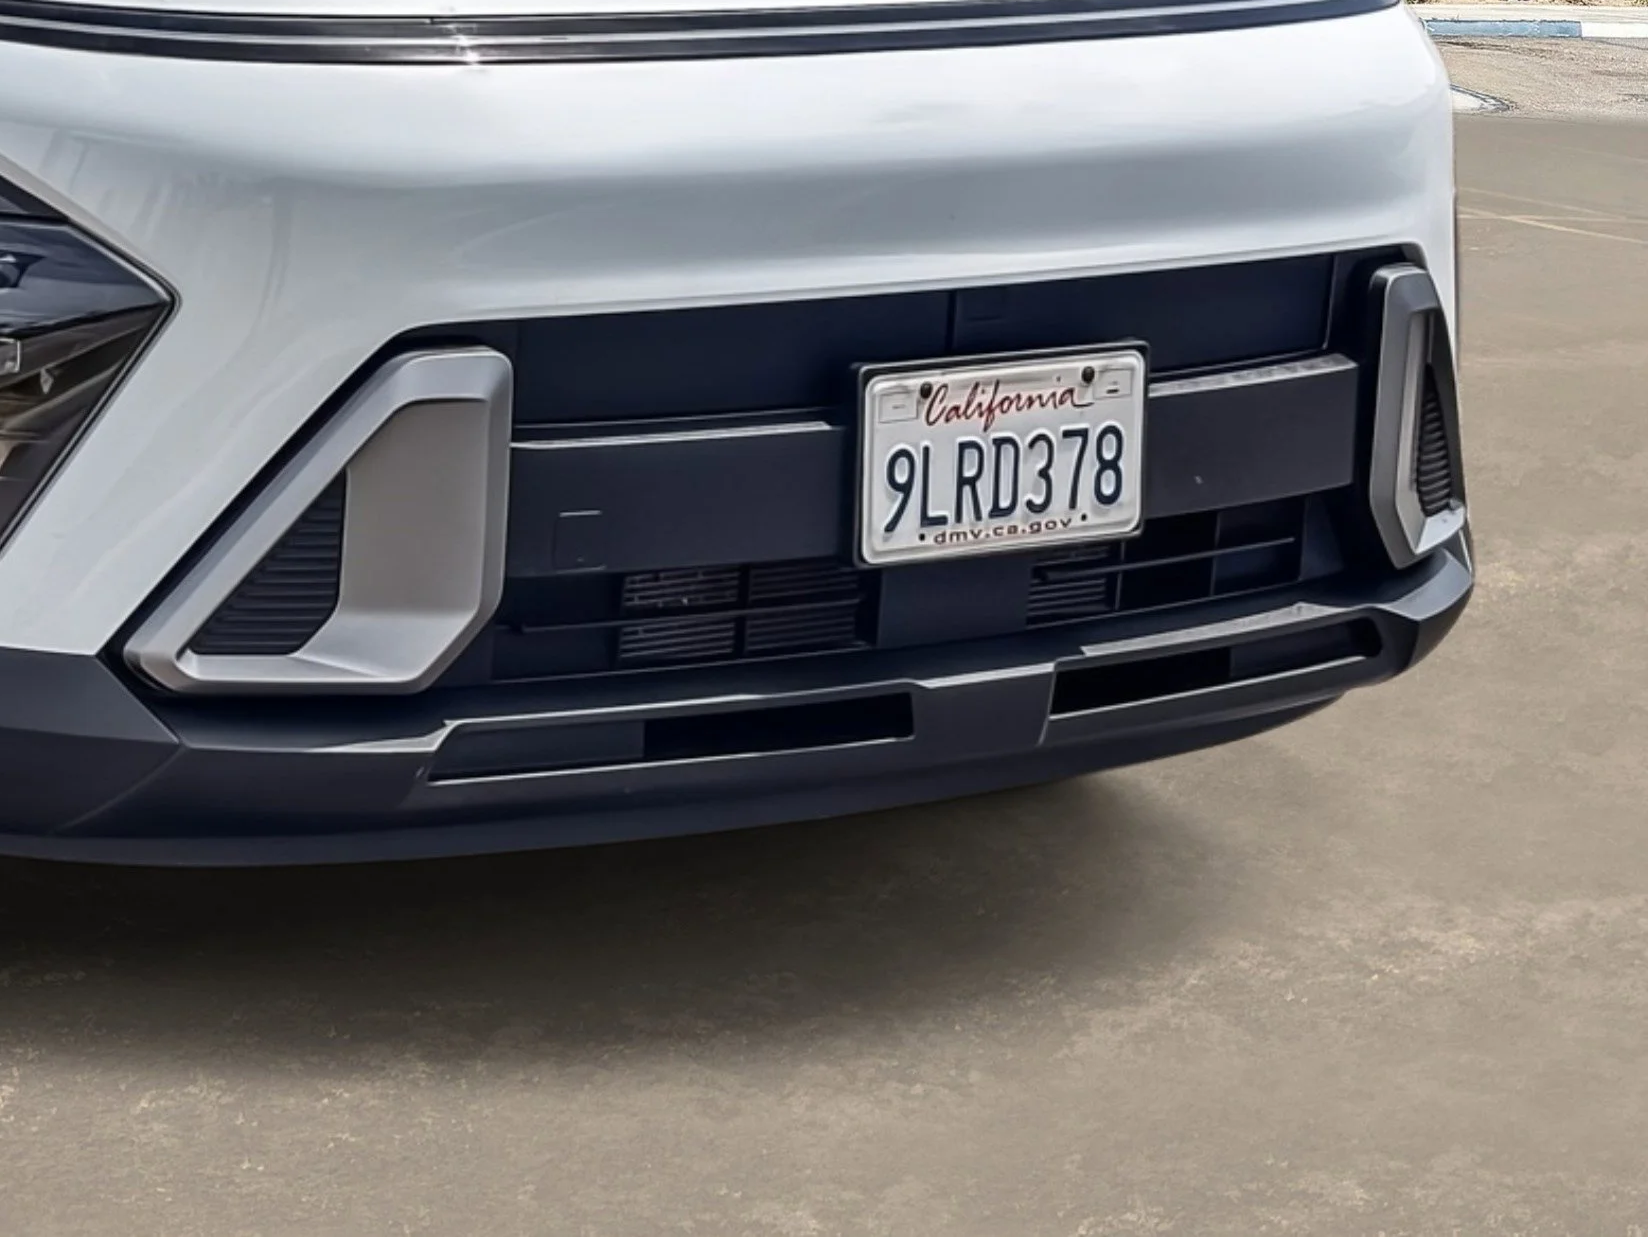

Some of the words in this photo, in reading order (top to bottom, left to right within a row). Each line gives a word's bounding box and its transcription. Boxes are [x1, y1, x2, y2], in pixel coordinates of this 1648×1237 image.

[923, 376, 1094, 433] California
[883, 424, 1124, 535] 9LRD378
[934, 517, 1073, 545] dmv.ca.gov
